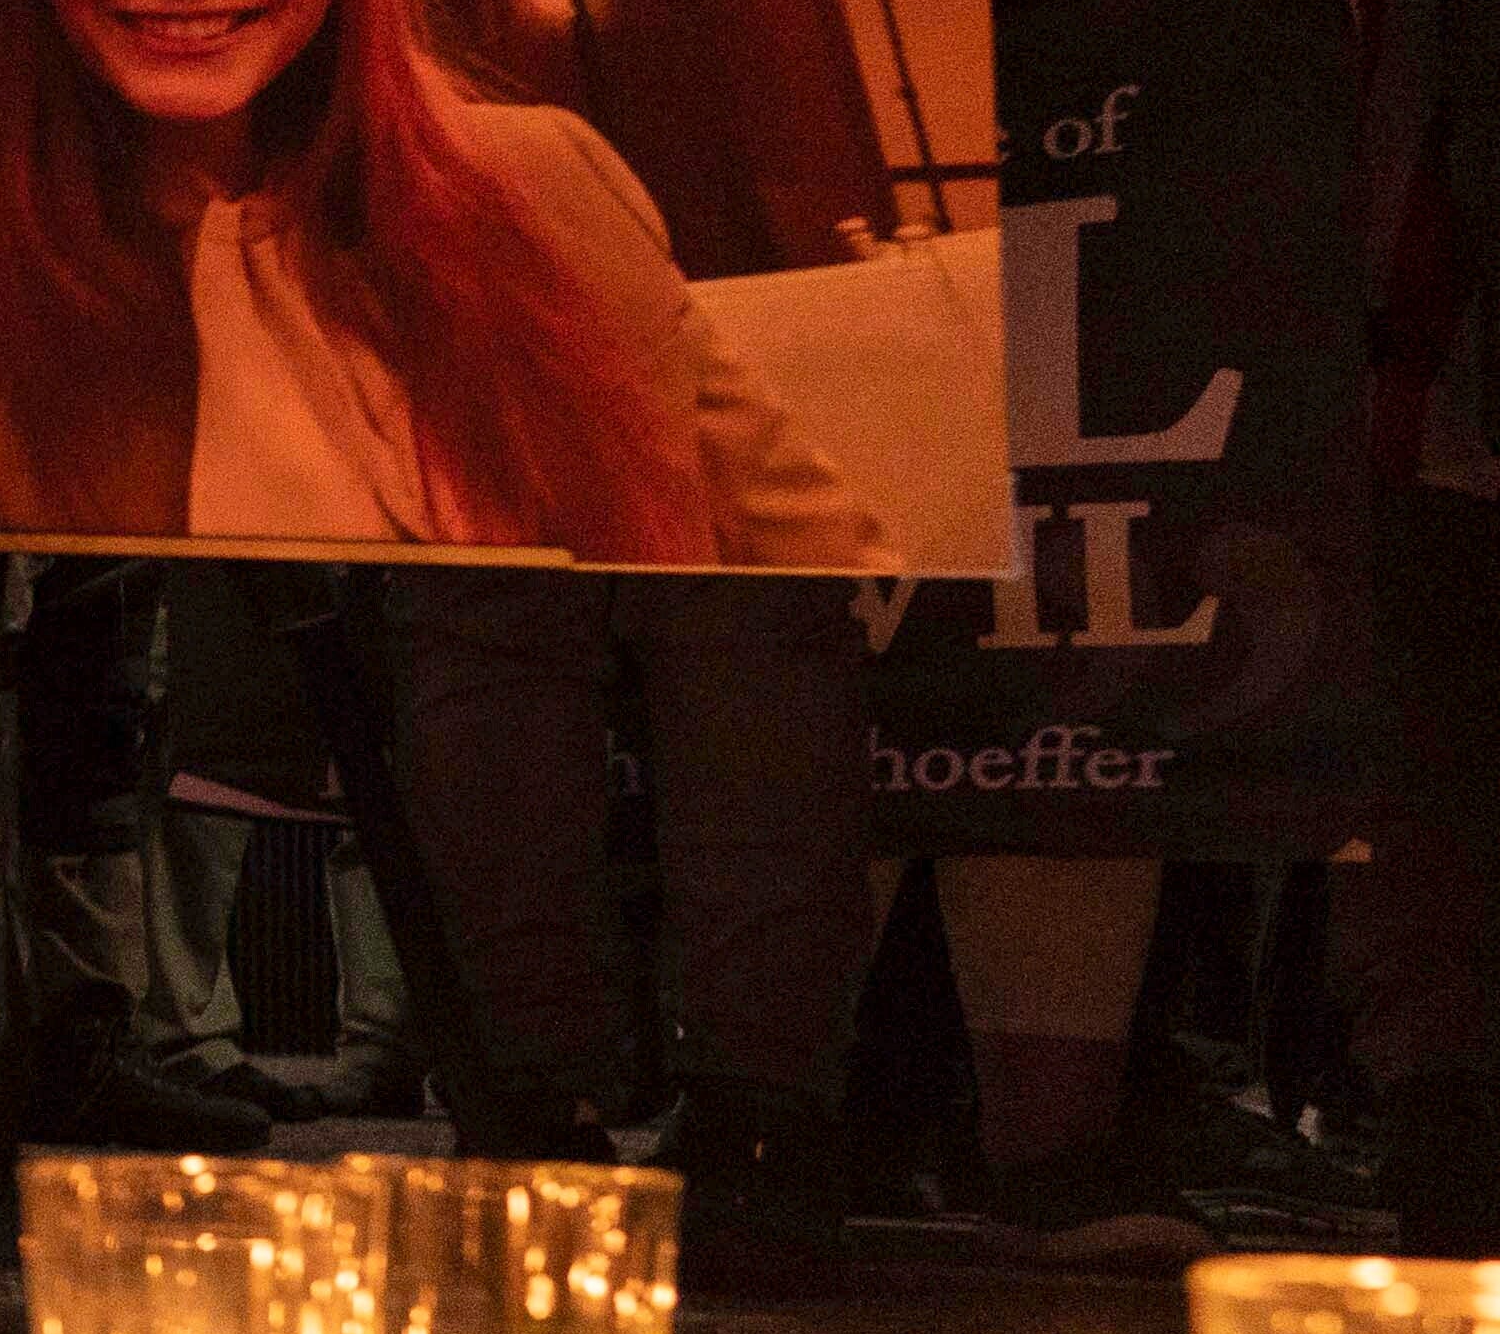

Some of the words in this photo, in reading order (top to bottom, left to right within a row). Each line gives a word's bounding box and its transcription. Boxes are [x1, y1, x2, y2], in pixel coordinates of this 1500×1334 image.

[1041, 81, 1141, 161] of
[848, 500, 1220, 654] IL
[870, 724, 1175, 791] hoeffer
